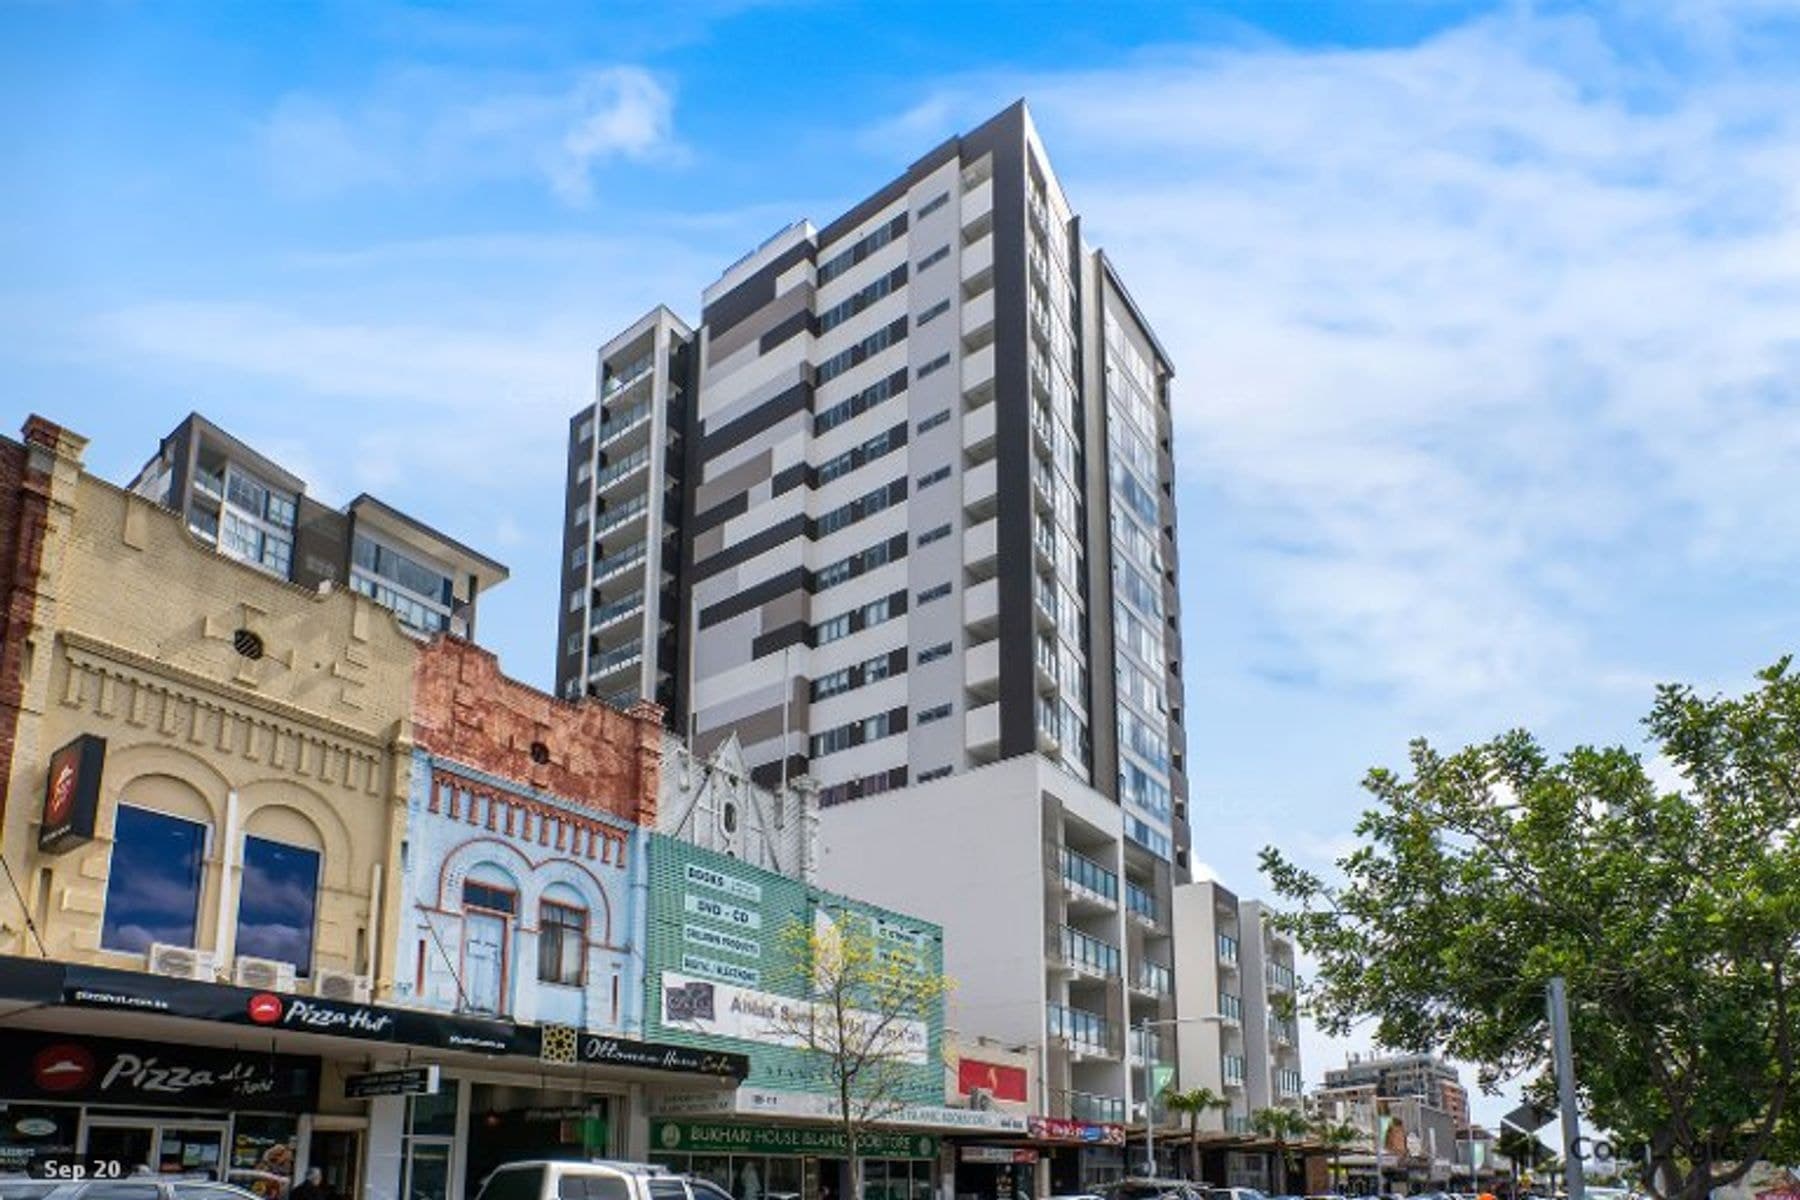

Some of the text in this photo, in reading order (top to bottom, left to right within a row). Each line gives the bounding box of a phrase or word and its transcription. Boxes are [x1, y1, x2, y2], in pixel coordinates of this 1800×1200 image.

[688, 866, 724, 887] BOOKS
[697, 898, 721, 917] DVD
[732, 909, 750, 924] CD
[284, 1000, 392, 1032] Pizza Hut
[100, 1053, 215, 1093] Pizza
[690, 1125, 752, 1144] BUKHARI
[754, 1128, 801, 1146] HOUSE
